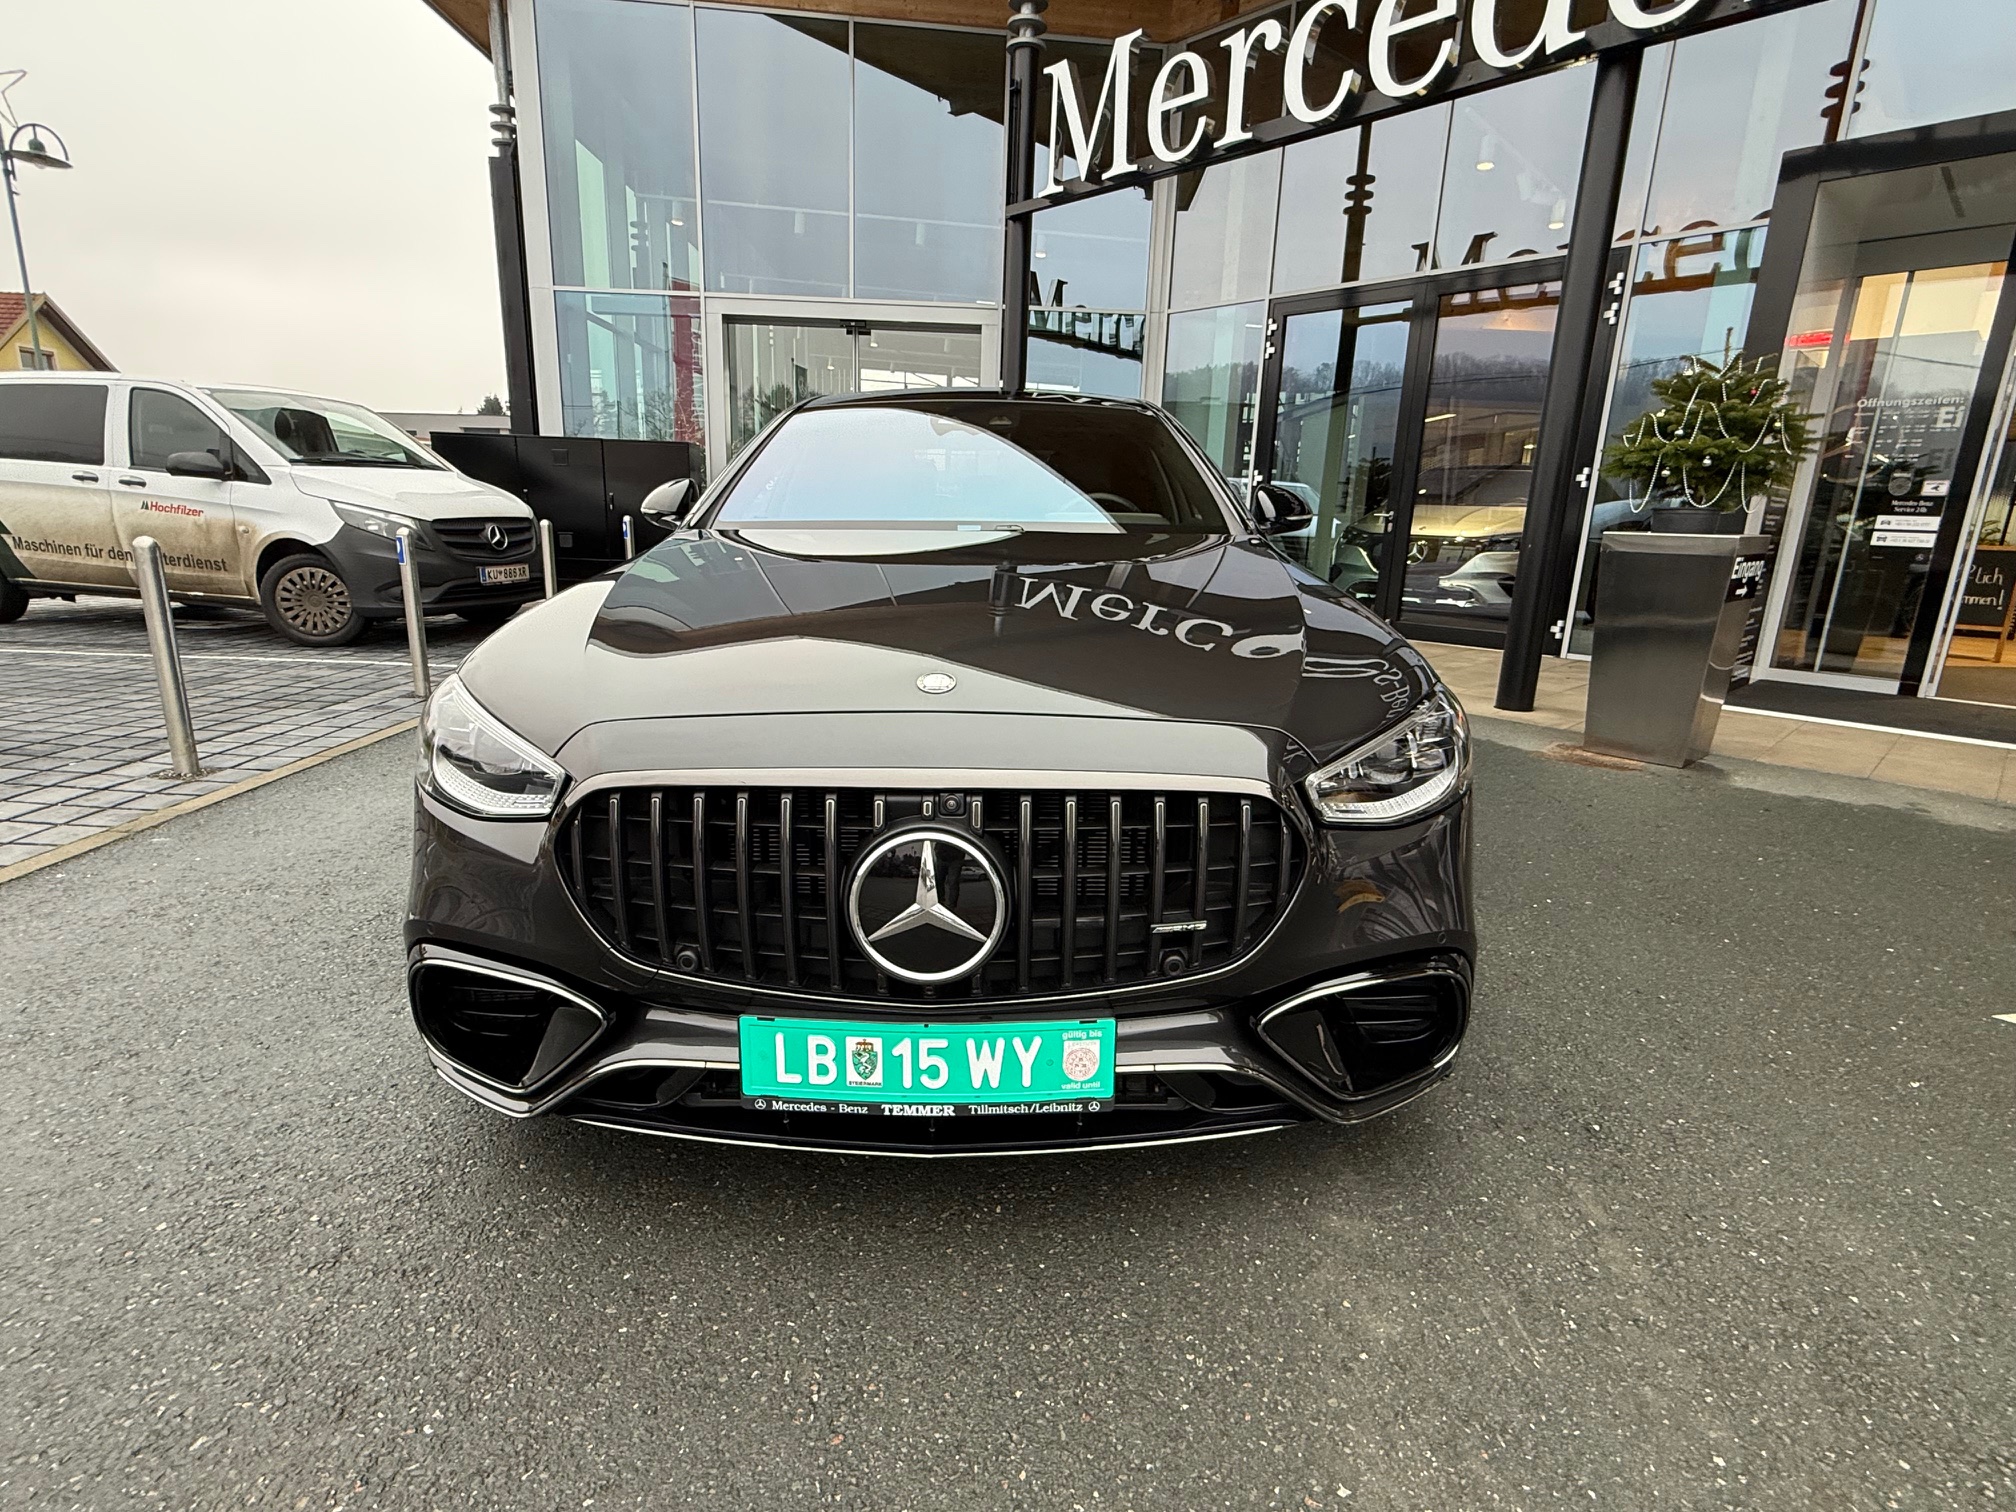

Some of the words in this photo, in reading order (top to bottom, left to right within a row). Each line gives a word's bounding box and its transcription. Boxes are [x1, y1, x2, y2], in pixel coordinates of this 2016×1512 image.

[1857, 396, 1965, 408] Öffnungszeiten:
[149, 500, 204, 517] Hochfilzer
[12, 535, 82, 556] Maschinen
[84, 543, 103, 559] für
[108, 546, 134, 562] den
[161, 552, 229, 572] terdienst
[1731, 556, 1766, 583] Eingang
[1061, 1030, 1087, 1041] gültig
[1089, 1029, 1103, 1038] bis
[775, 1032, 838, 1085] LB
[891, 1037, 949, 1089] 15
[966, 1035, 1042, 1089] WY
[1061, 1082, 1081, 1090] valid
[1082, 1080, 1101, 1089] until
[771, 1100, 828, 1113] Mercedes
[838, 1103, 869, 1115] Benz
[881, 1104, 956, 1117] TEMMER
[968, 1102, 1083, 1115] Tillmitsch/Leibnitz
